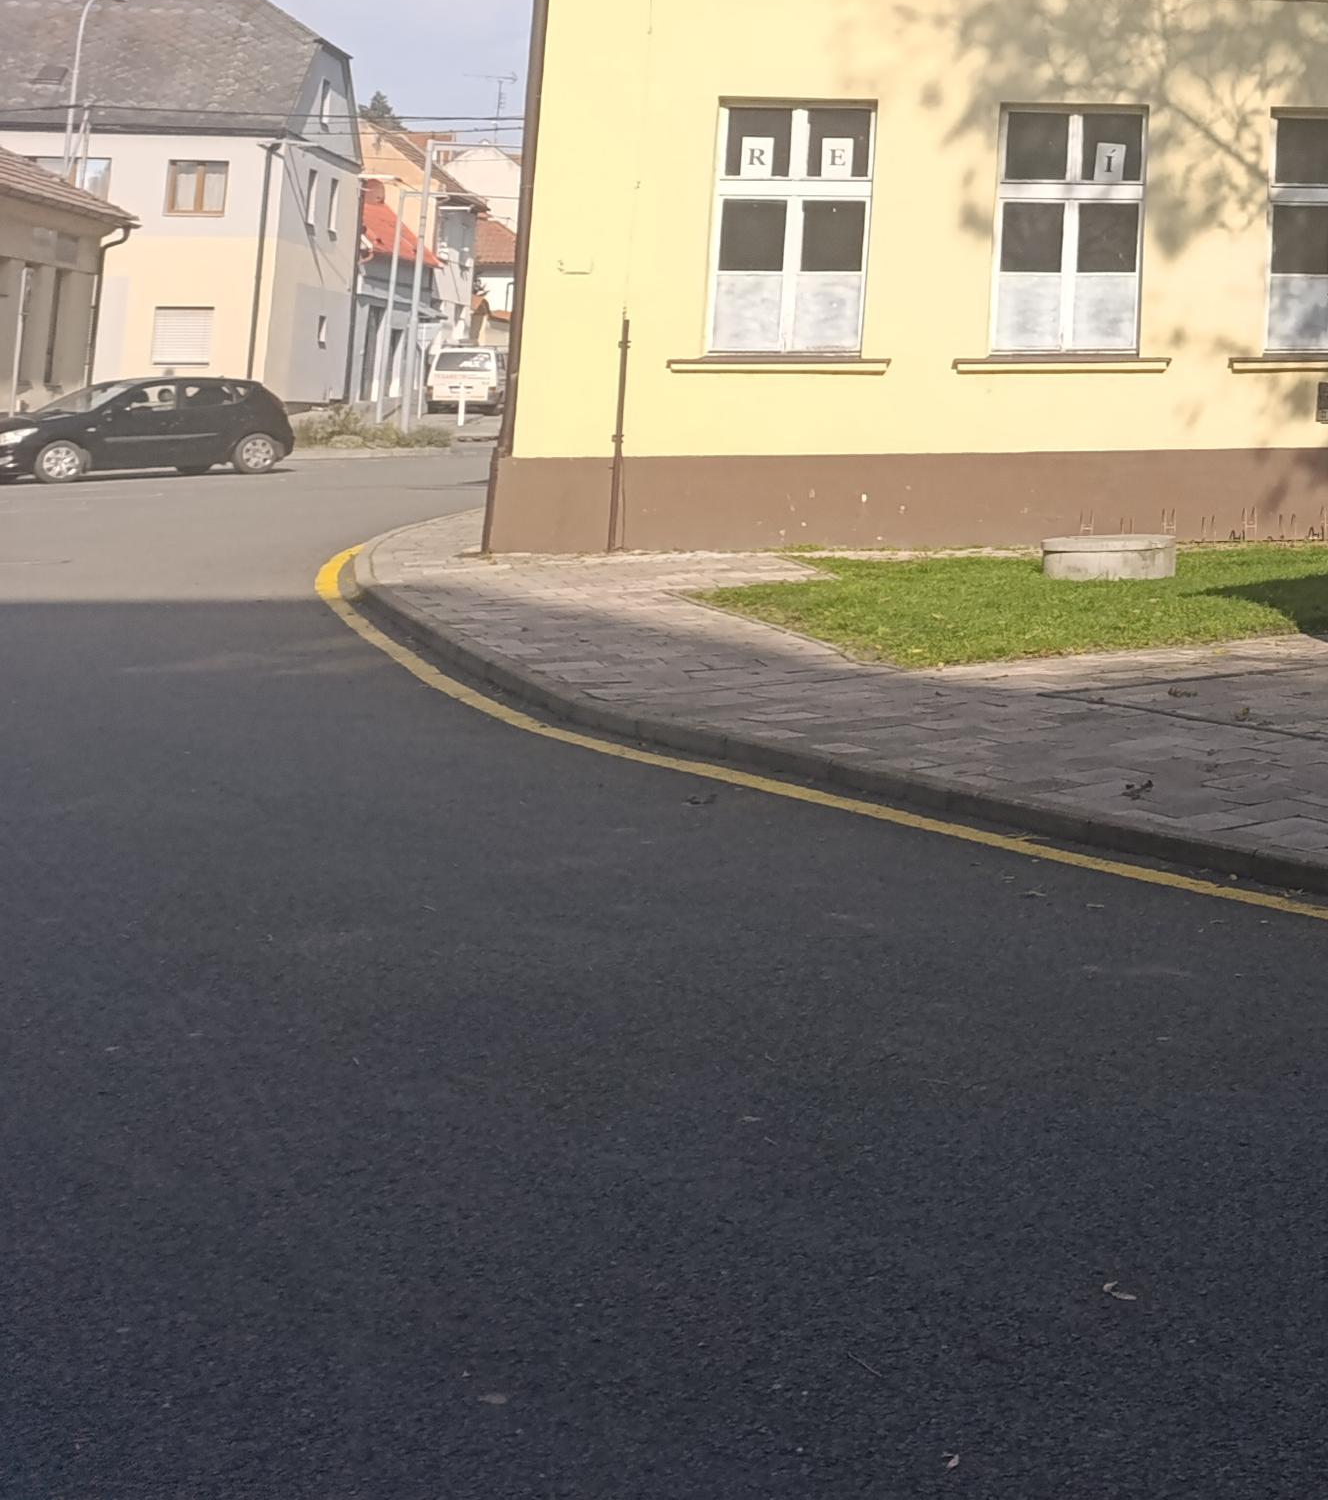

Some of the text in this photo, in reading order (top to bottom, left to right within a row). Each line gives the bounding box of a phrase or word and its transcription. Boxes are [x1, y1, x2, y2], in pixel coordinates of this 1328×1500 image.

[747, 147, 766, 165] R
[829, 148, 846, 166] E
[1104, 148, 1116, 172] Í
